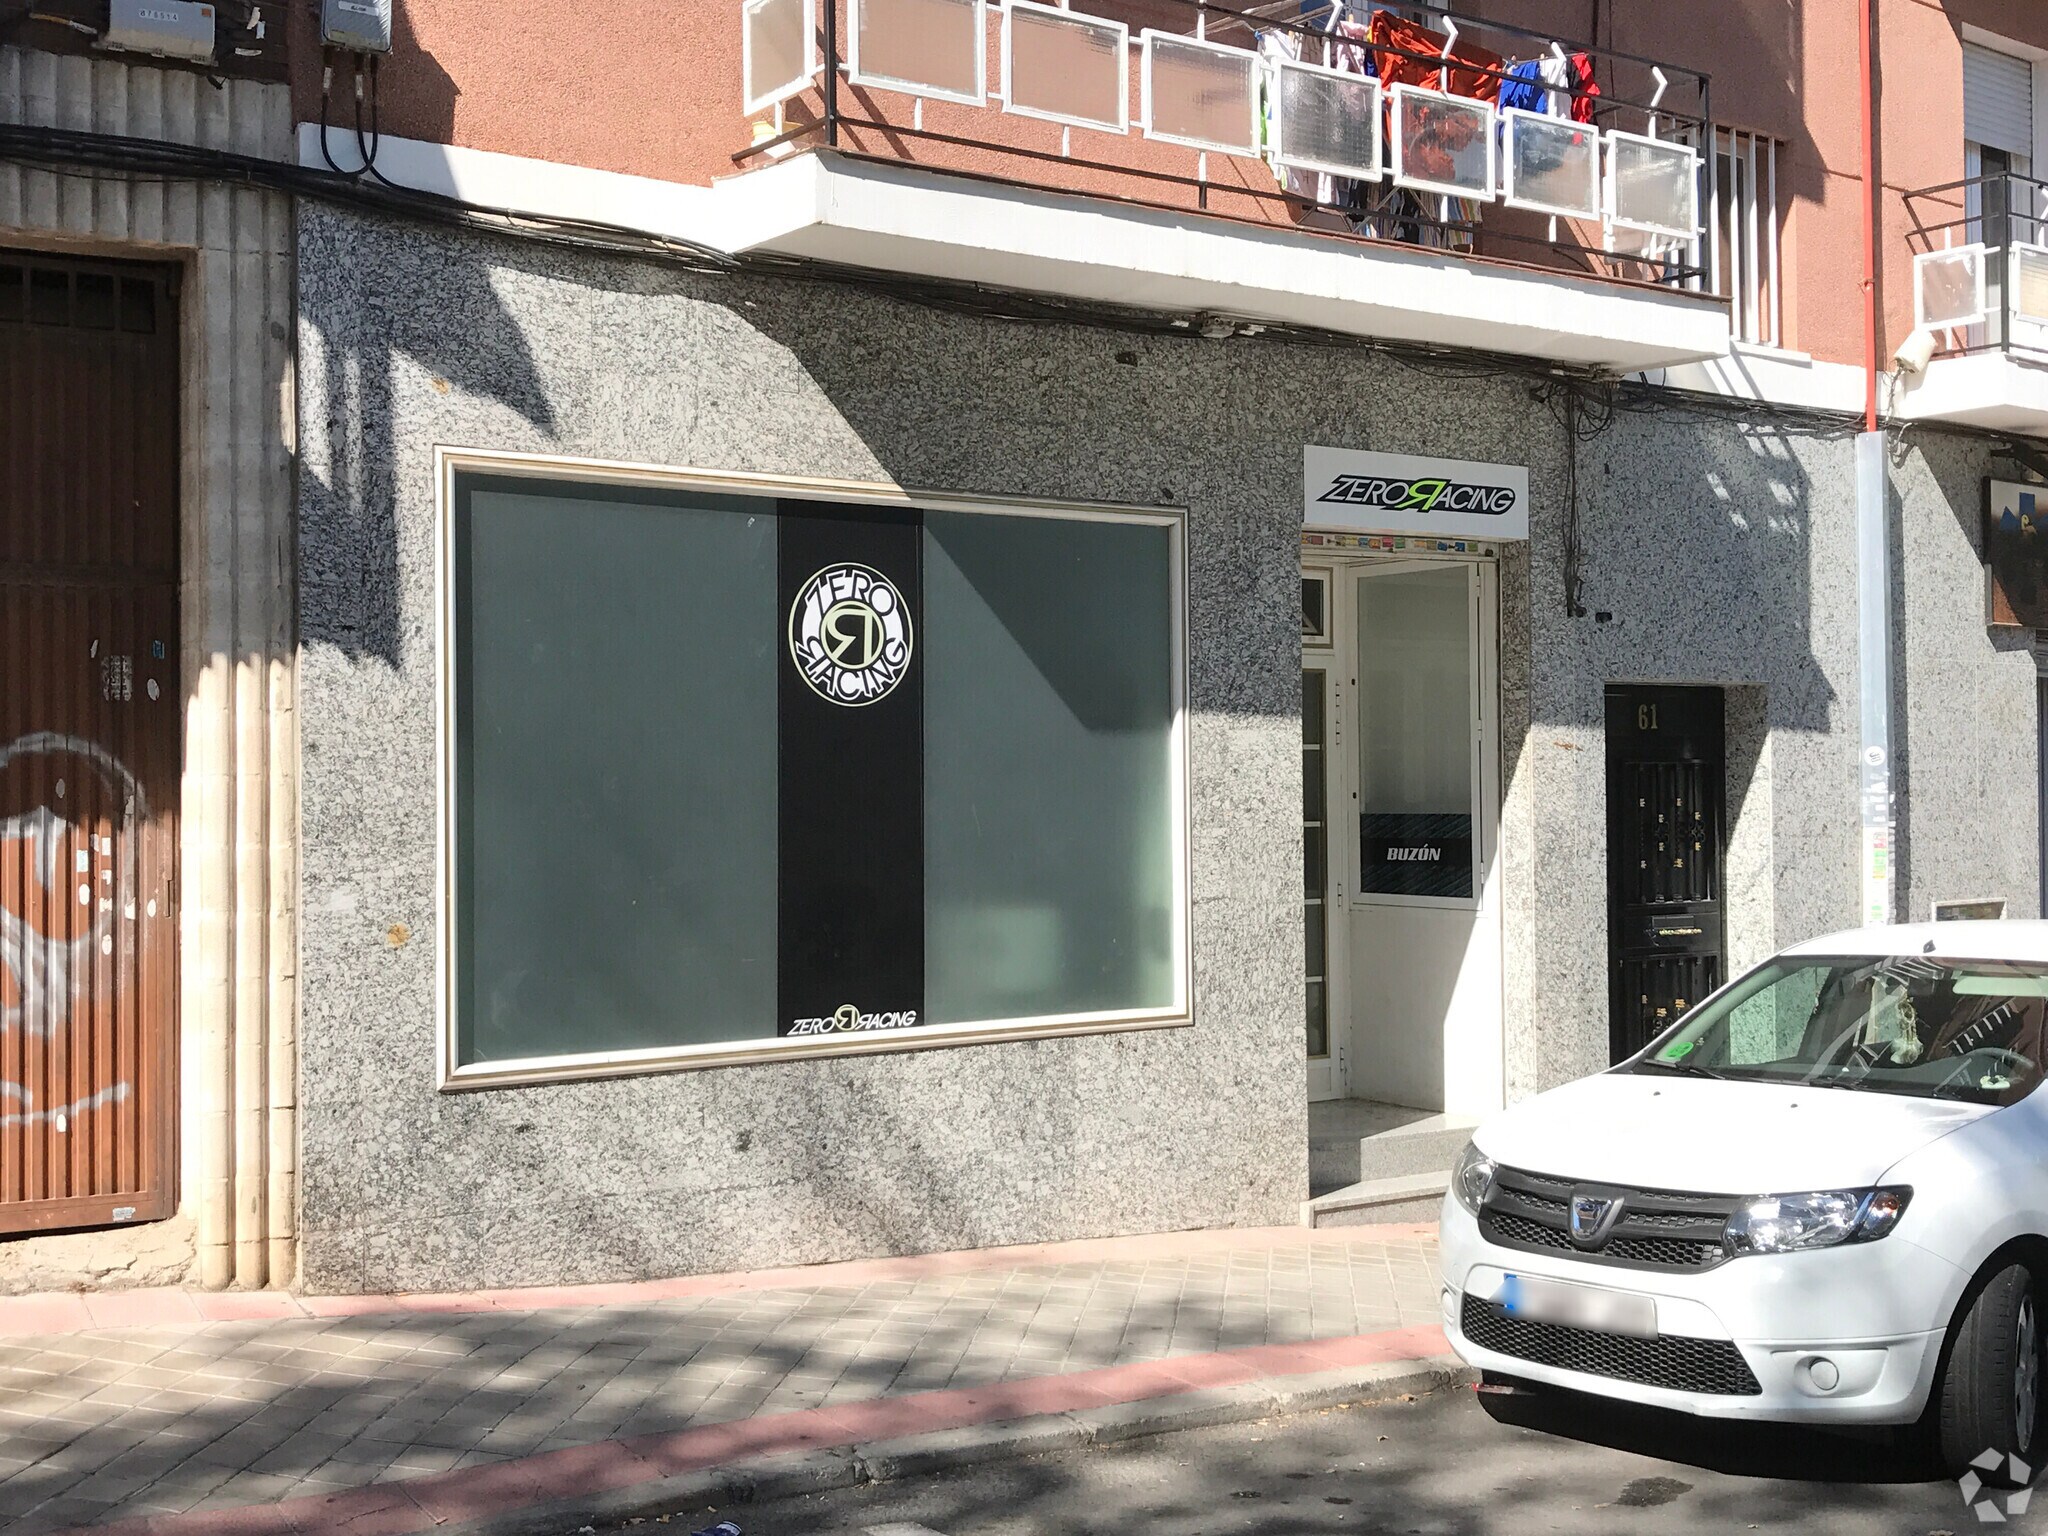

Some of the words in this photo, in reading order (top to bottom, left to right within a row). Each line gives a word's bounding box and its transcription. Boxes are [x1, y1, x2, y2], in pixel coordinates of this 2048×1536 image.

[804, 569, 898, 618] ZERO
[1637, 703, 1659, 730] 61
[1386, 843, 1441, 861] BUZÓN
